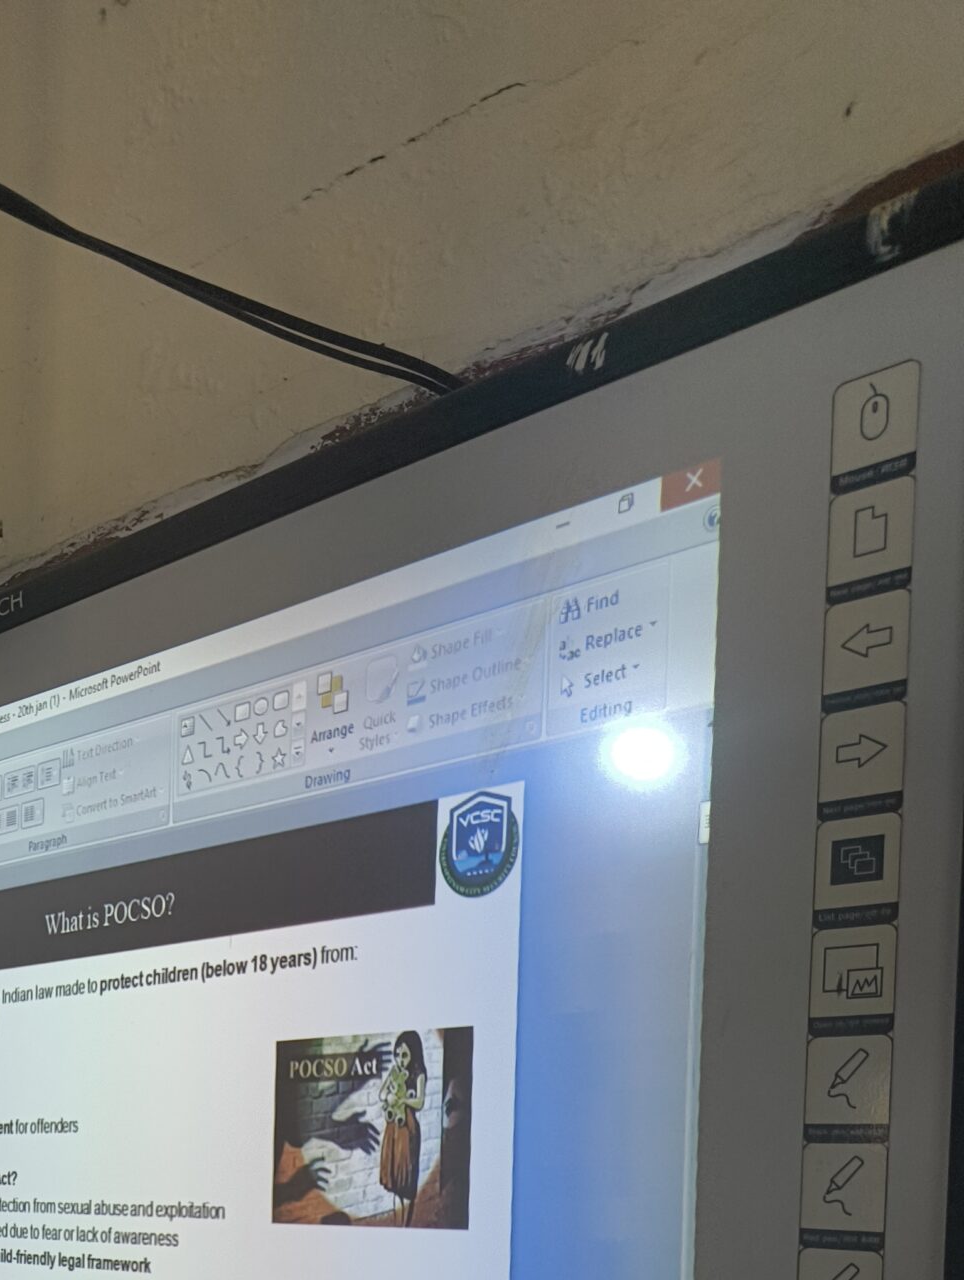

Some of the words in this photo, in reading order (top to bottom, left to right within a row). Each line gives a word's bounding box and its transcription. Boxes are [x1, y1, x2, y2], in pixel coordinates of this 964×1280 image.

[587, 590, 620, 613] Find
[430, 639, 464, 661] Shape
[469, 628, 493, 650] Fill
[585, 623, 643, 652] Replace
[430, 672, 469, 695] Shape
[472, 657, 522, 682] Outline
[584, 664, 627, 689] Select
[17, 704, 34, 718] 20th
[34, 701, 48, 716] jan
[49, 694, 60, 710] (1)
[69, 678, 108, 701] Microsoft
[110, 661, 161, 688] PowerPoint
[363, 710, 397, 731] Quick
[428, 708, 467, 730] Shape
[470, 695, 513, 719] Effects
[580, 699, 633, 727] Editing
[310, 722, 354, 745] Arrange
[359, 732, 391, 752] Styles
[77, 747, 94, 760] Text
[95, 736, 133, 756] Direction
[76, 774, 98, 789] Align
[99, 768, 117, 782] Text
[305, 767, 351, 790] Drawing
[76, 799, 107, 817] Convert
[109, 796, 118, 809] to
[120, 786, 157, 805] SmartArt
[458, 809, 502, 828] VCSC
[28, 833, 67, 851] Paragraph
[45, 910, 84, 935] What
[86, 906, 100, 930] is
[103, 892, 175, 927] POCSO?
[2, 986, 34, 1005] Indian
[35, 983, 53, 1001] law
[55, 980, 86, 999] made
[87, 978, 98, 994] to
[100, 972, 144, 996] protect
[145, 964, 198, 987] children
[201, 958, 248, 984] (below
[251, 954, 268, 973] 18
[270, 947, 318, 975] years)
[320, 945, 358, 966] from:
[289, 1056, 348, 1079] POCSO
[350, 1058, 378, 1076] Act
[15, 1118, 29, 1134] for
[29, 1118, 79, 1134] offenders
[32, 1198, 56, 1214] from
[57, 1199, 92, 1215] sexual
[94, 1200, 129, 1216] abuse
[130, 1201, 153, 1217] and
[155, 1202, 225, 1221] exploitation
[9, 1223, 28, 1239] due
[30, 1225, 40, 1240] to
[41, 1224, 62, 1241] fear
[63, 1229, 75, 1242] or
[76, 1226, 98, 1243] lack
[100, 1227, 112, 1244] of
[113, 1230, 179, 1247] awareness
[58, 1252, 85, 1271] legal
[87, 1254, 152, 1274] framework
